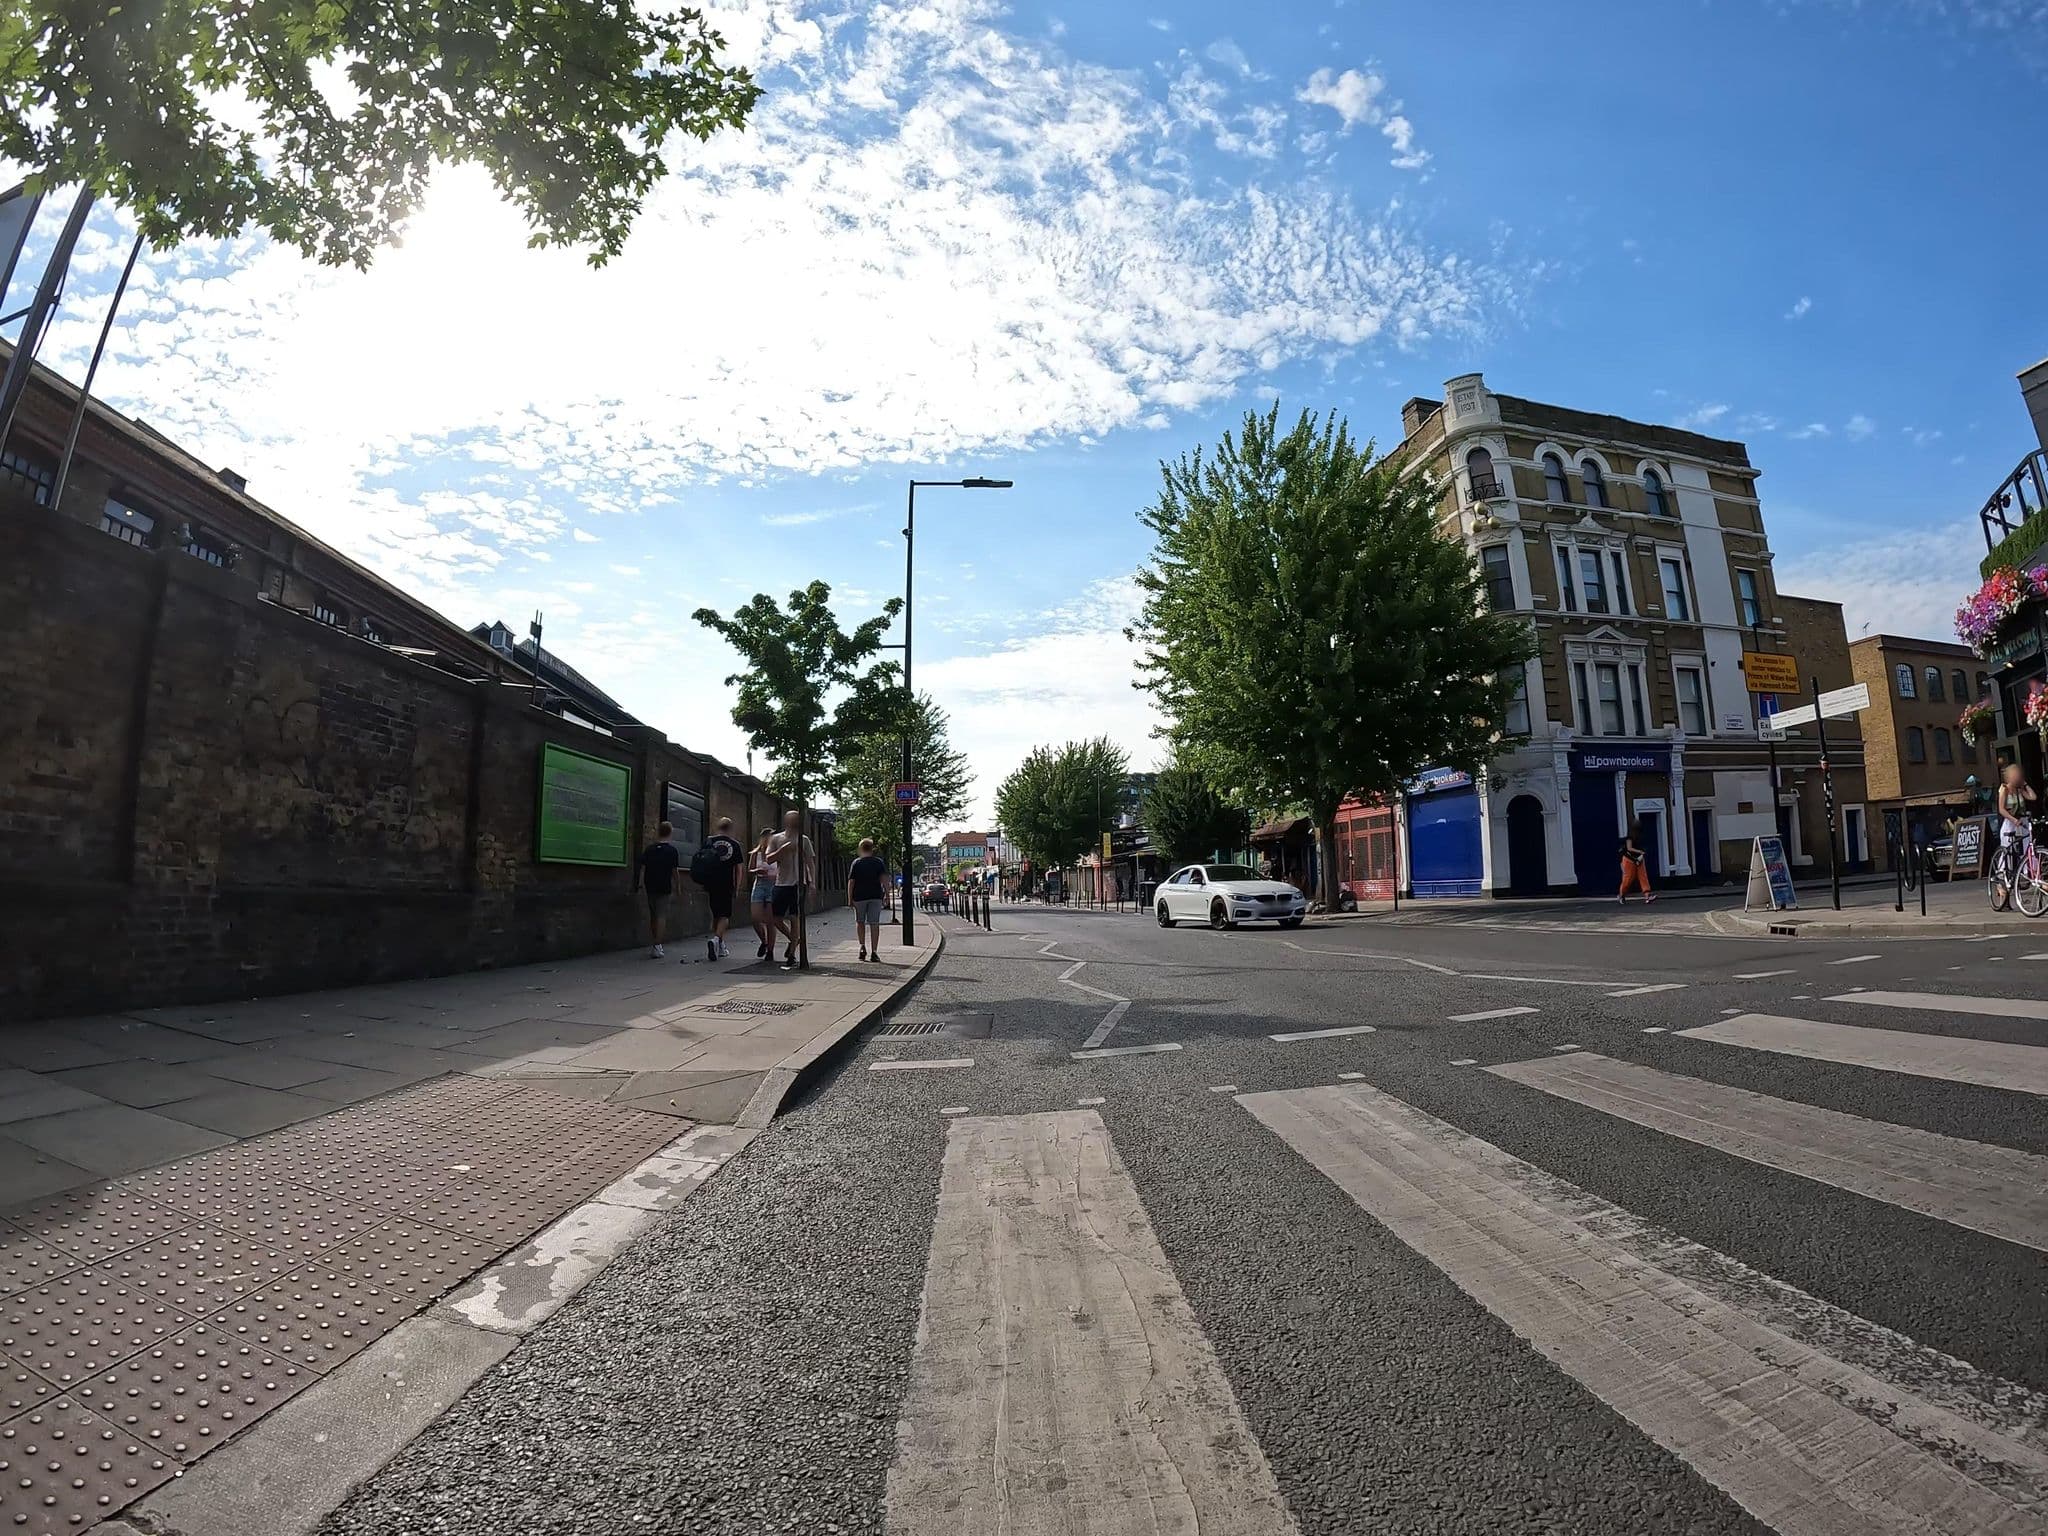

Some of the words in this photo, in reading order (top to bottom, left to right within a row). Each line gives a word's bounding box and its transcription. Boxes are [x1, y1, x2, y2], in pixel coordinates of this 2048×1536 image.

[1761, 731, 1783, 739] cyes
[1596, 755, 1655, 769] pawnbrokers
[1416, 772, 1460, 789] pbrokers
[1957, 830, 1981, 847] ROAST
